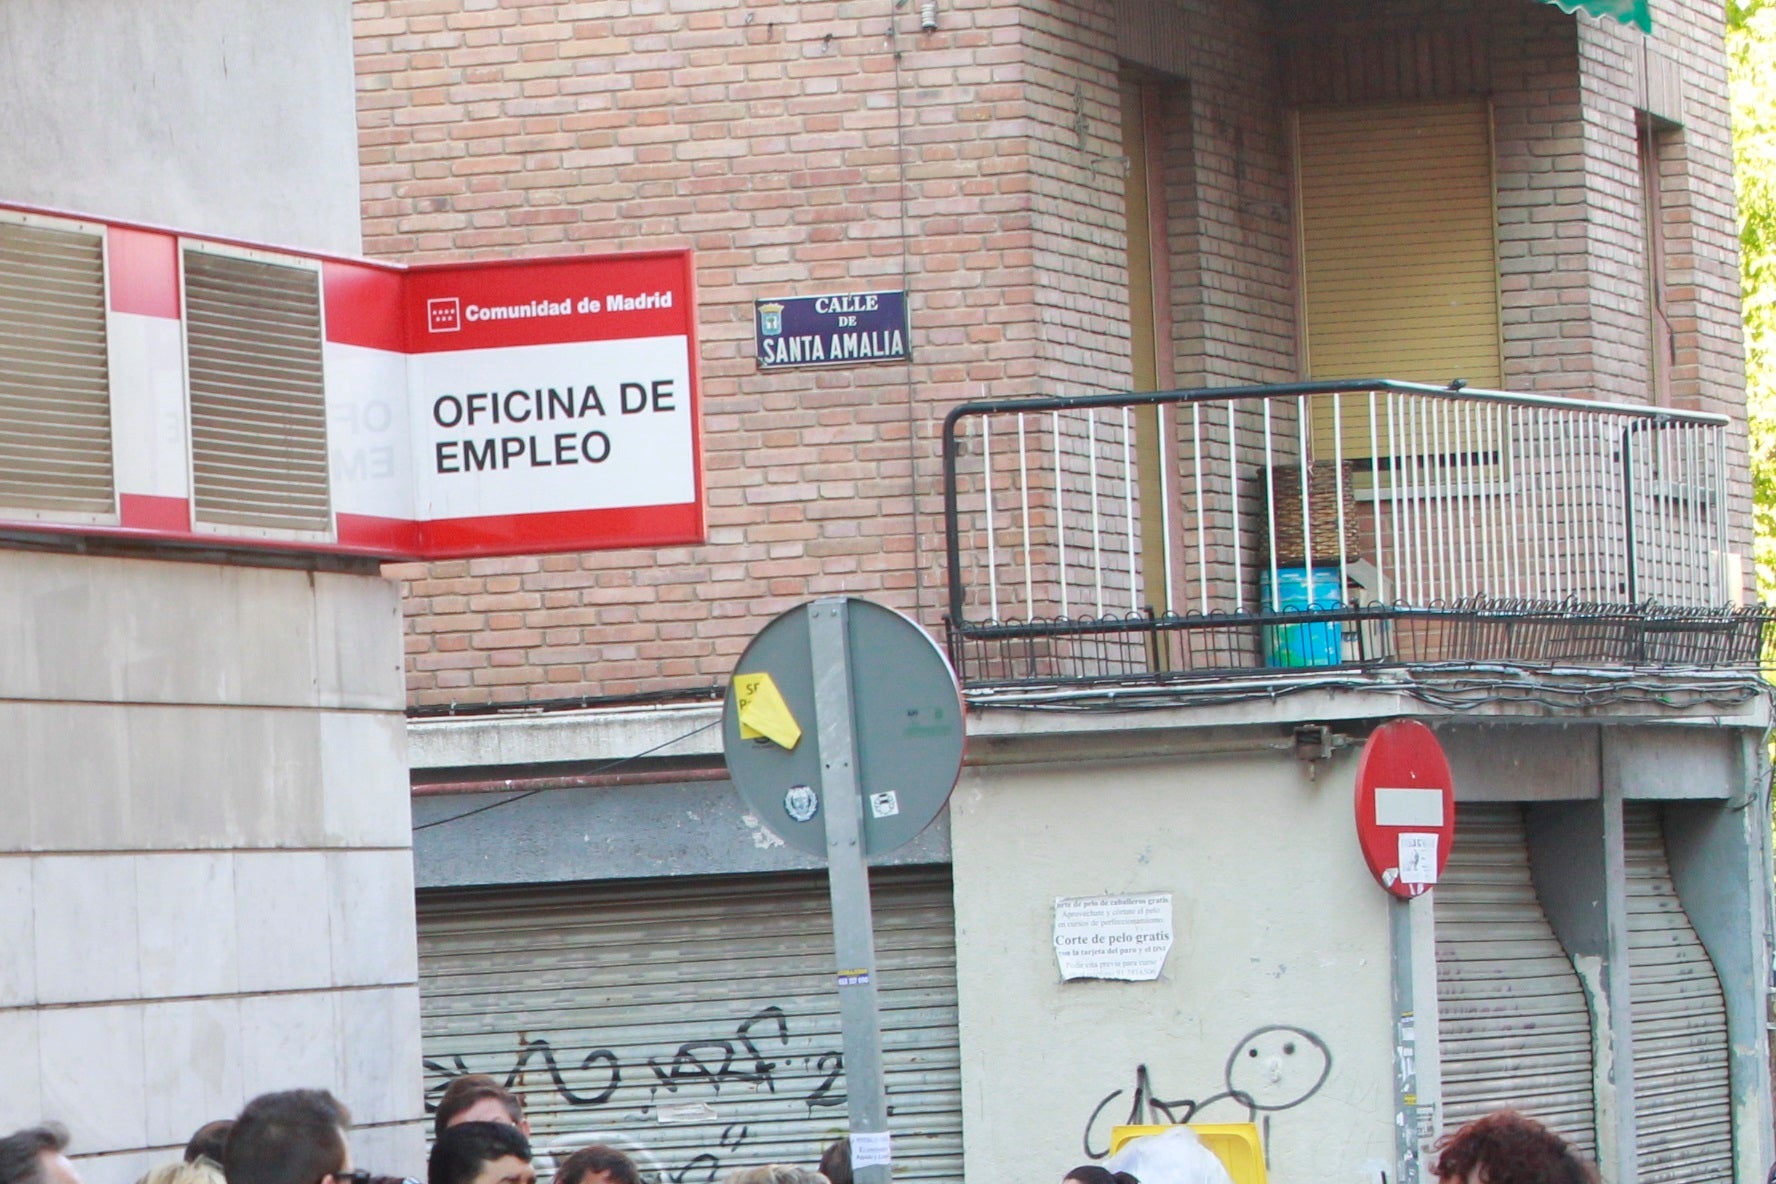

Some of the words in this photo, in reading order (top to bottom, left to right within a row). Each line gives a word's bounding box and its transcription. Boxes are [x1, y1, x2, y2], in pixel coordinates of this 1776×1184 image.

[465, 298, 571, 321] Comunidad
[577, 297, 601, 315] de
[606, 291, 673, 312] Madrid
[815, 295, 879, 313] CALLE
[838, 316, 857, 327] DE
[763, 335, 824, 364] SANTA
[830, 330, 904, 359] AMALIA
[433, 385, 606, 428] OFICINA
[620, 379, 675, 415] DE
[436, 430, 611, 474] EMPLEO
[1055, 934, 1089, 946] Corte
[1092, 934, 1105, 944] de
[1109, 932, 1133, 946] pelo
[1135, 930, 1170, 943] gratis
